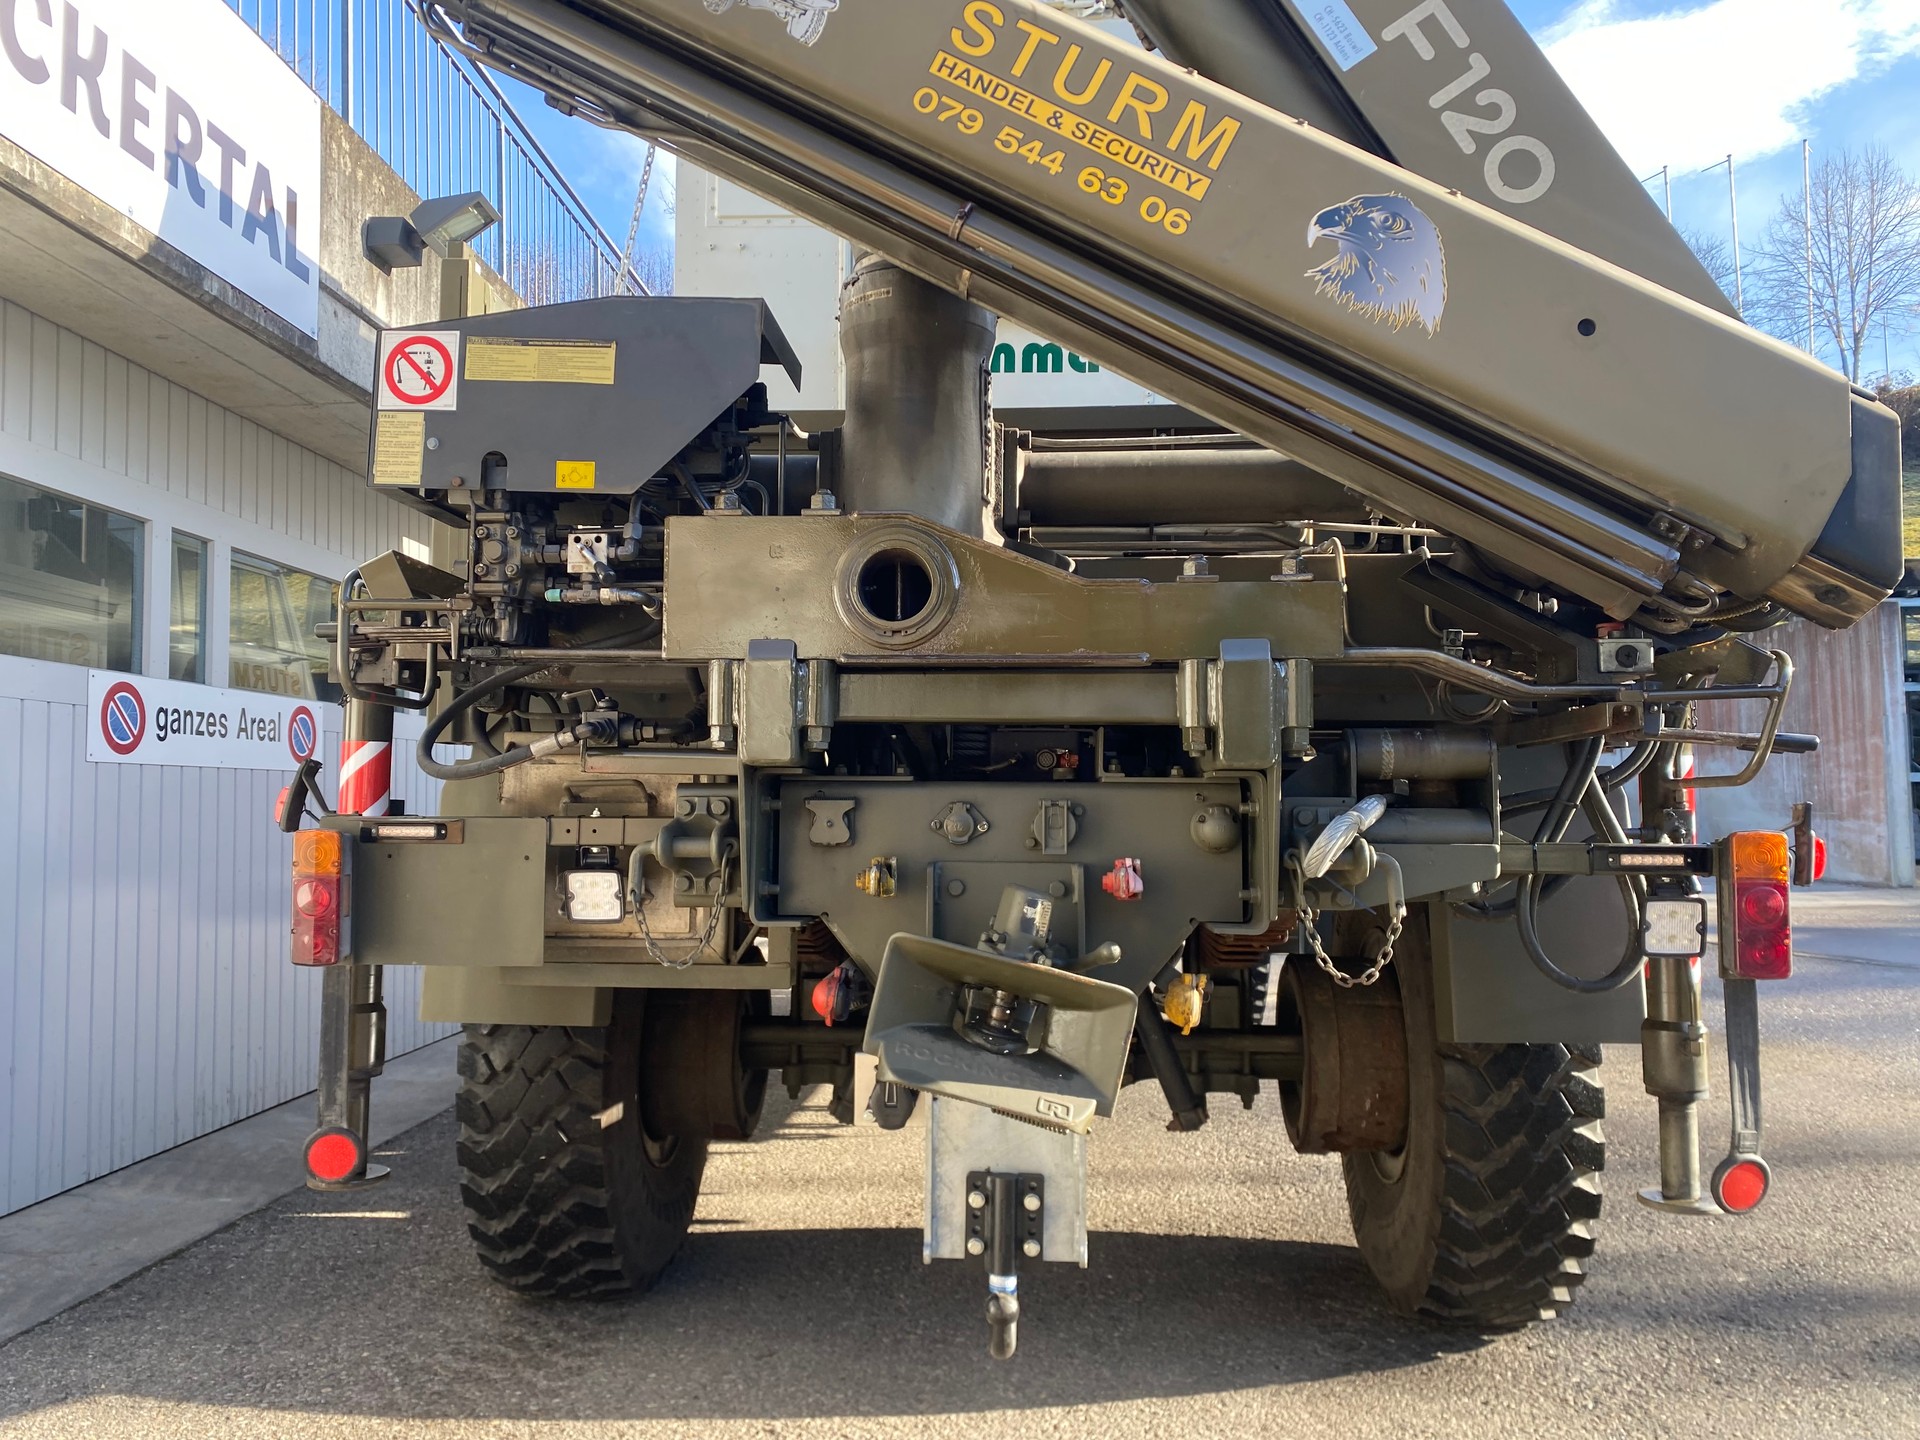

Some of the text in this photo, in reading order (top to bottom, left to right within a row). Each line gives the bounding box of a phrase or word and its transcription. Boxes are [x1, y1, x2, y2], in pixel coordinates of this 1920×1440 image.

[0, 0, 310, 285] CKERTAL
[912, 86, 1193, 235] 079 544 63 06
[937, 56, 1204, 193] HANDEL & SECURITY
[950, 0, 1242, 172] STURM
[1381, 0, 1556, 204] F120
[155, 706, 281, 743] ganzes Areal
